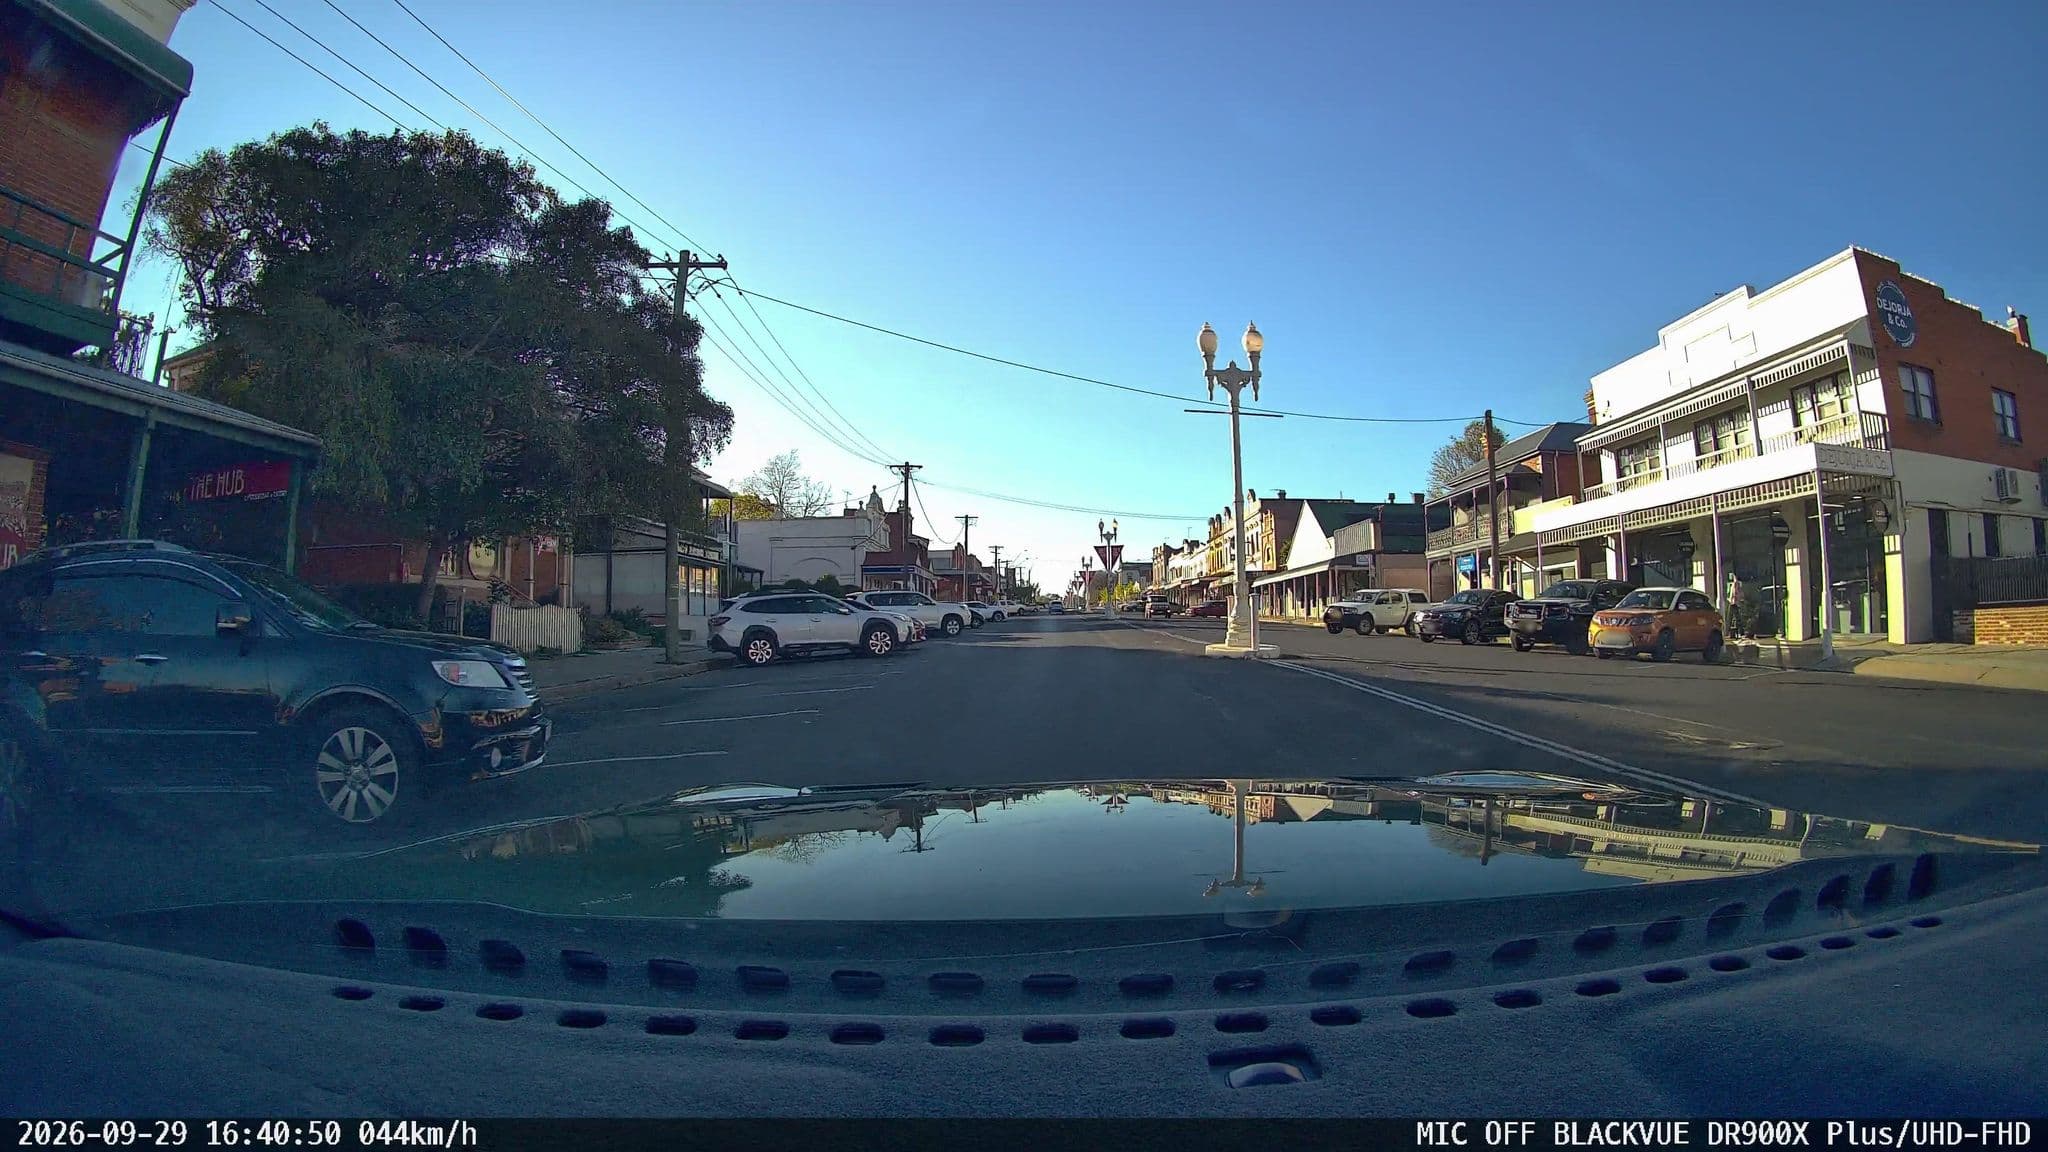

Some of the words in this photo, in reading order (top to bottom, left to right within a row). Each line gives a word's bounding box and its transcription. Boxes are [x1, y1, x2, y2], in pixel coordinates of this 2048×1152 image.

[1876, 297, 1912, 318] DEJORJA
[1887, 313, 1895, 325] &
[215, 469, 244, 497] HUB
